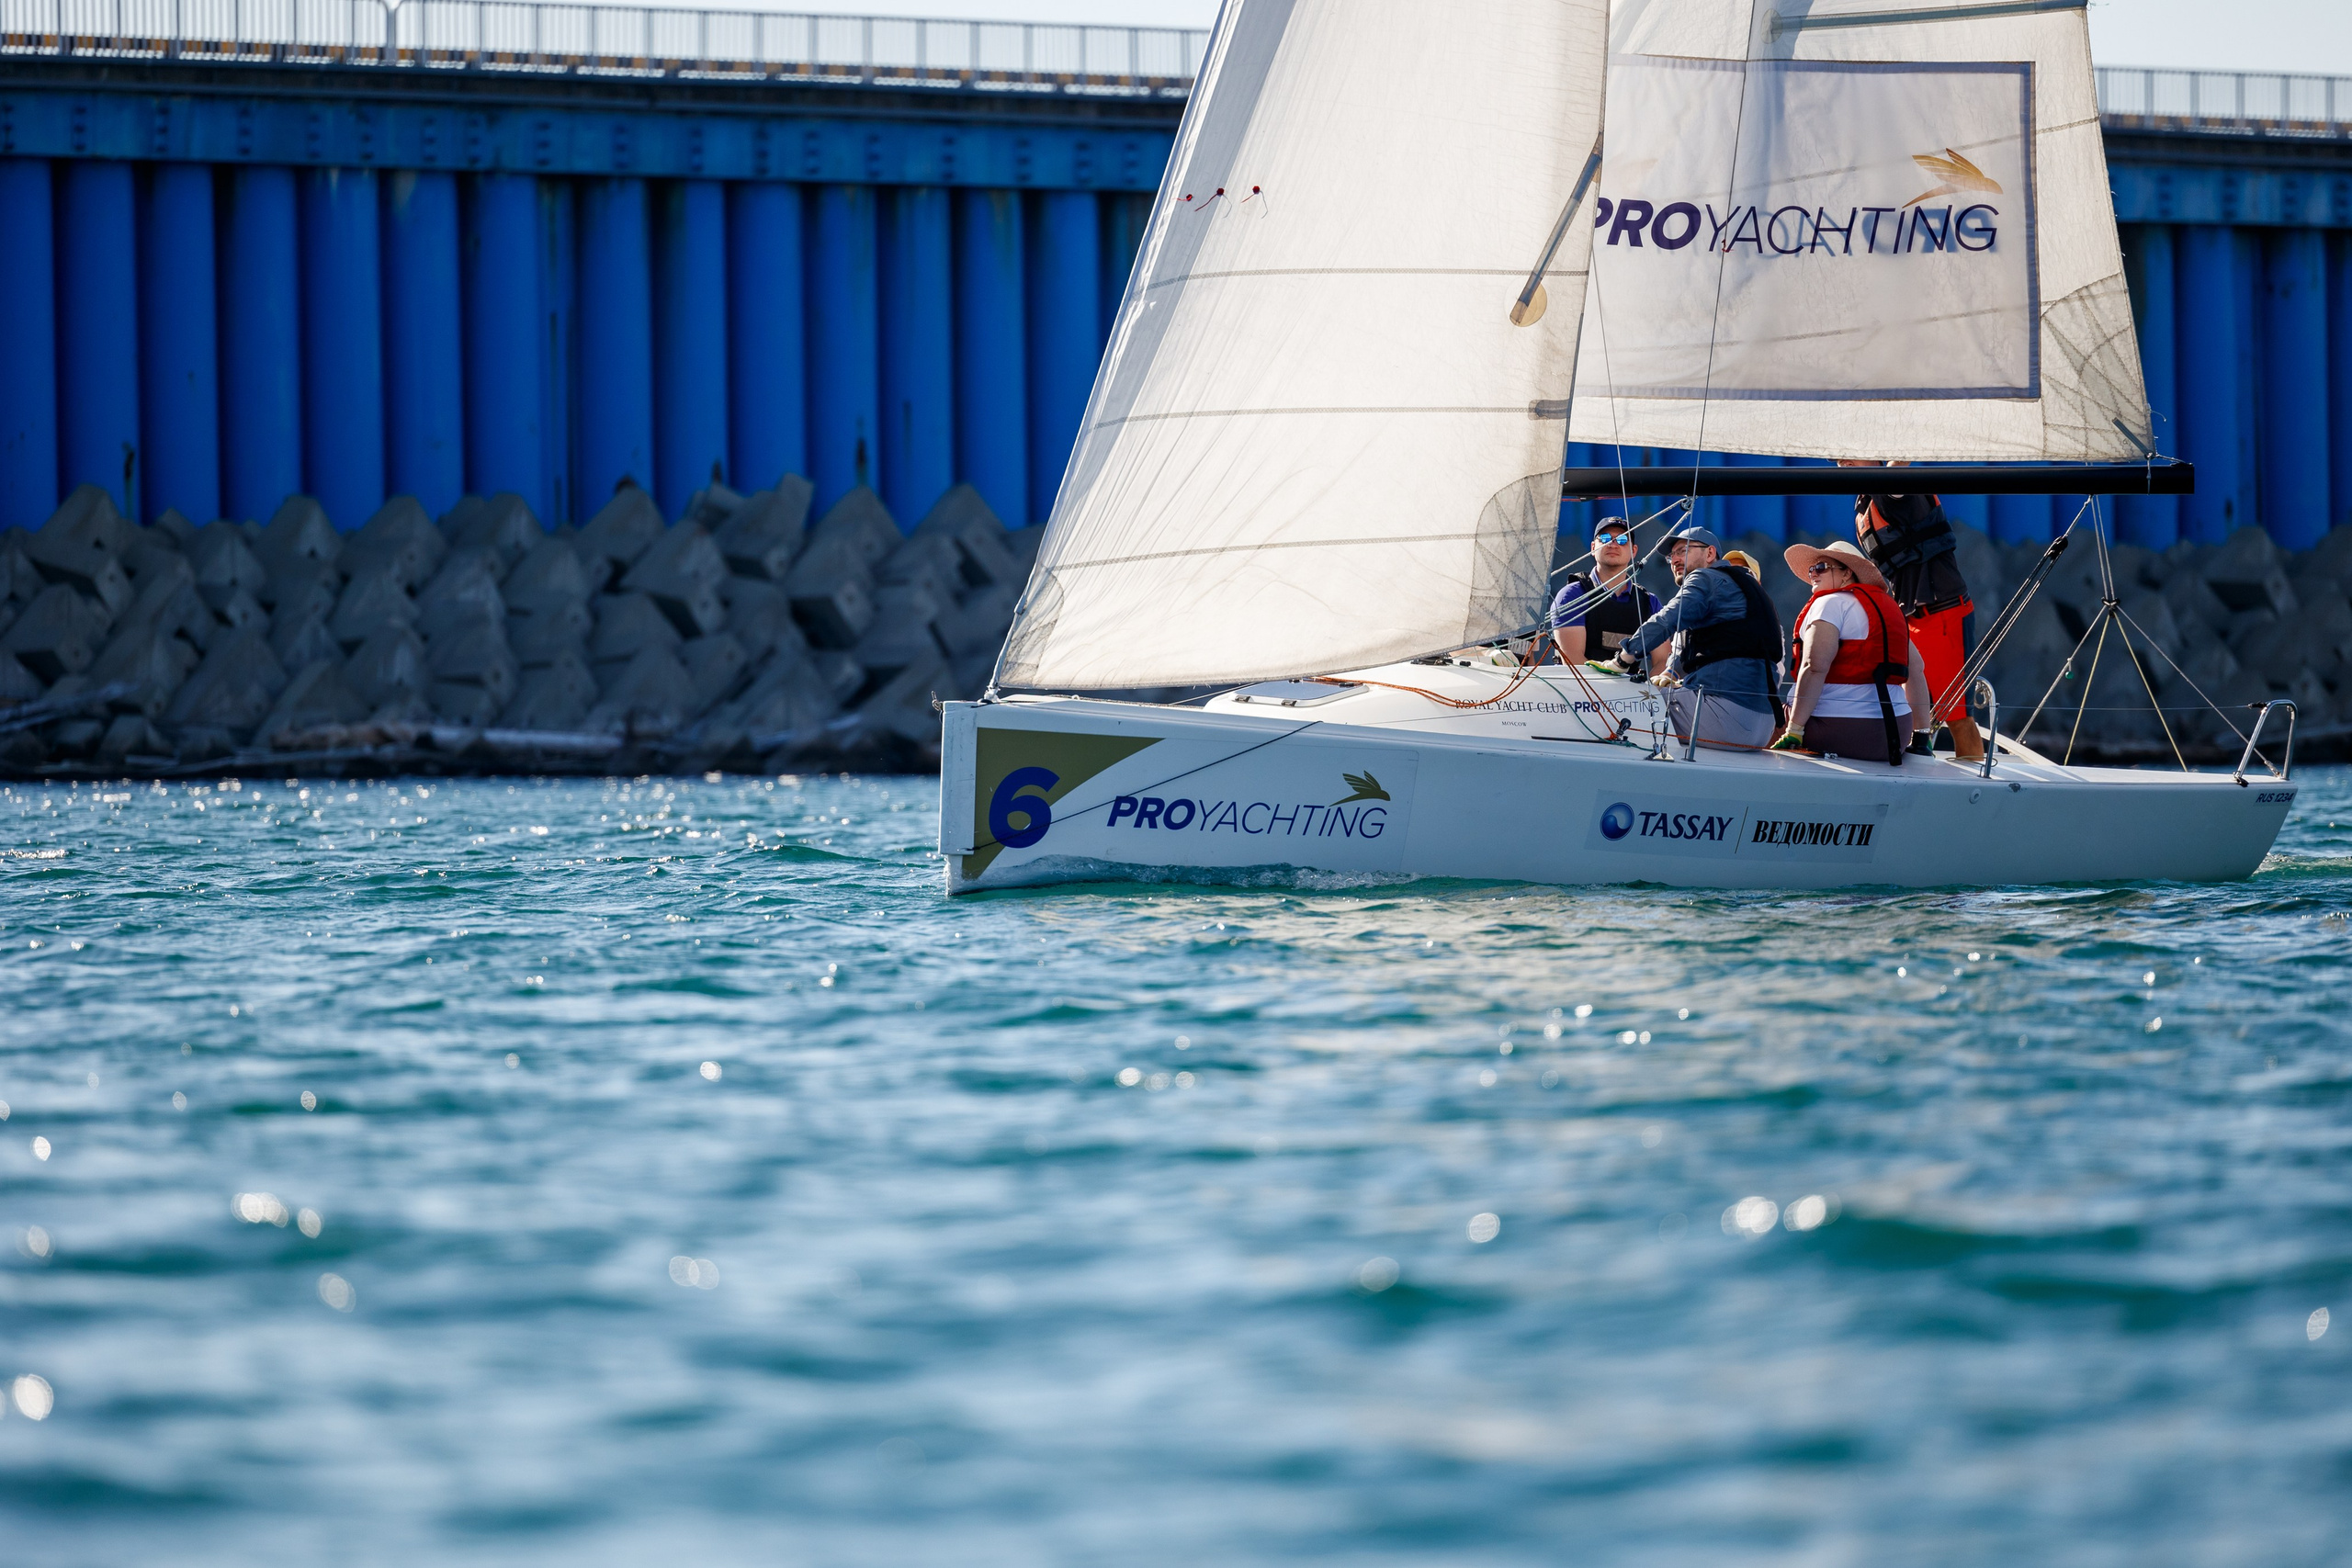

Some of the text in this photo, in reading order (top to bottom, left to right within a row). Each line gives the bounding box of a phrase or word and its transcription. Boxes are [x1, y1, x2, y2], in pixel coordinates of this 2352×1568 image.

[1455, 698, 1660, 715] ROYAL YACHT CLUB PROYACHTING
[989, 766, 1060, 849] 6
[2256, 793, 2294, 802] RUS 1234
[1106, 795, 1388, 839] PROYACHTING
[1638, 811, 1735, 841] TASSAY
[1751, 819, 1875, 849] ВЕДОМОСТИ
